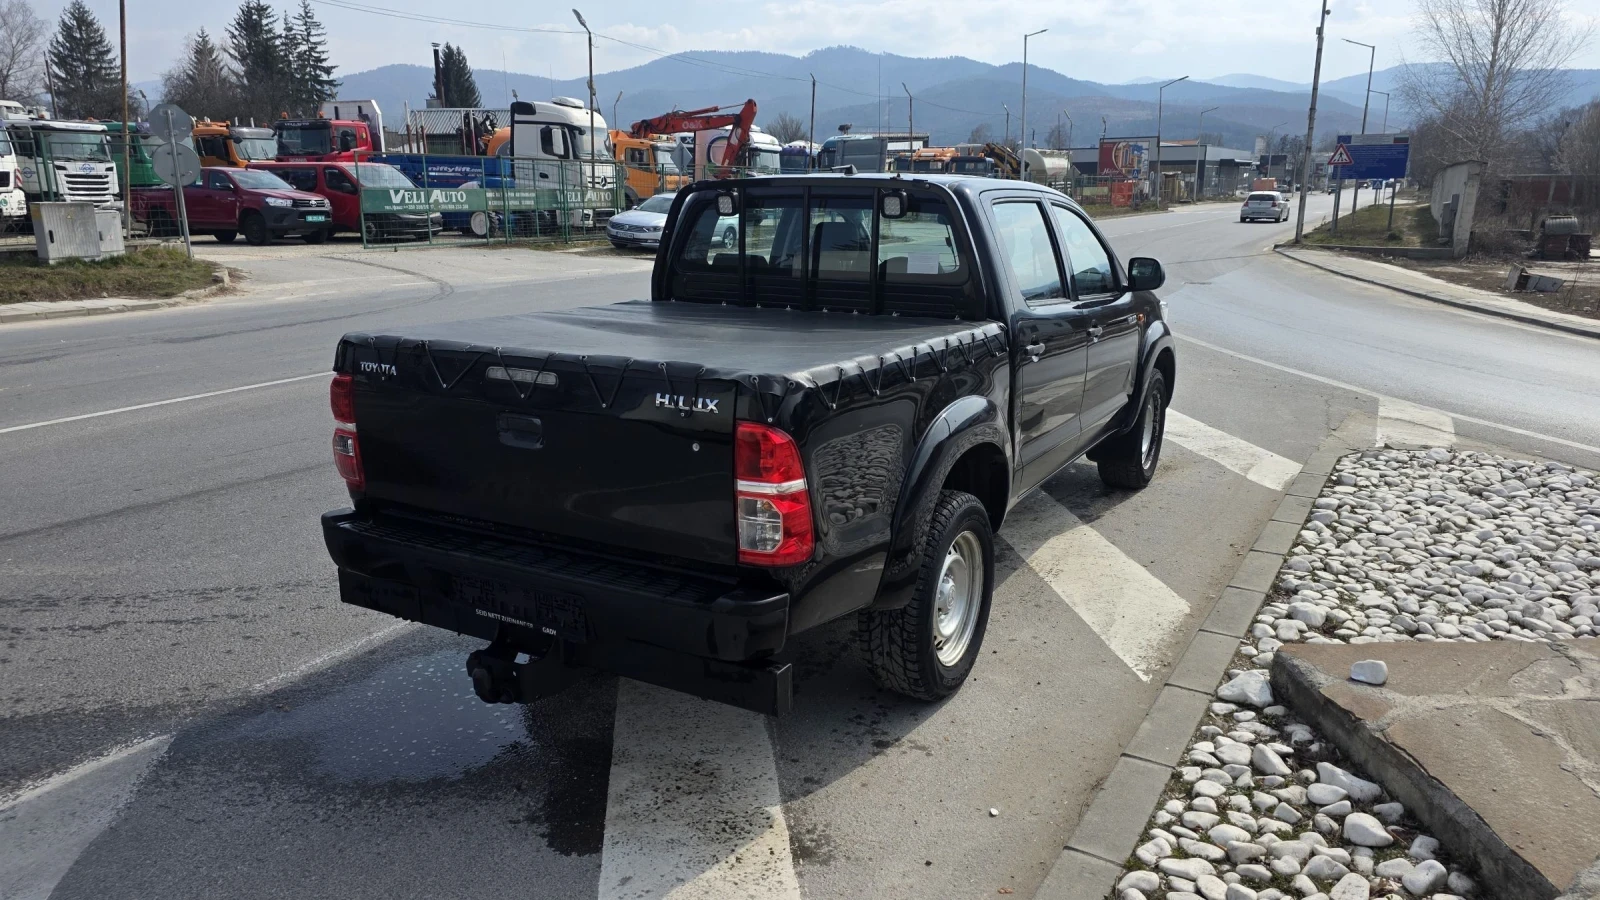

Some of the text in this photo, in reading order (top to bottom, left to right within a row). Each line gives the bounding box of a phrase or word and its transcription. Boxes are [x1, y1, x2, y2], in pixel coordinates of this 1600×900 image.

[389, 189, 467, 204] VELI AUTO
[584, 189, 612, 202] AUTO
[475, 608, 487, 617] SEID
[488, 612, 500, 620] NETT
